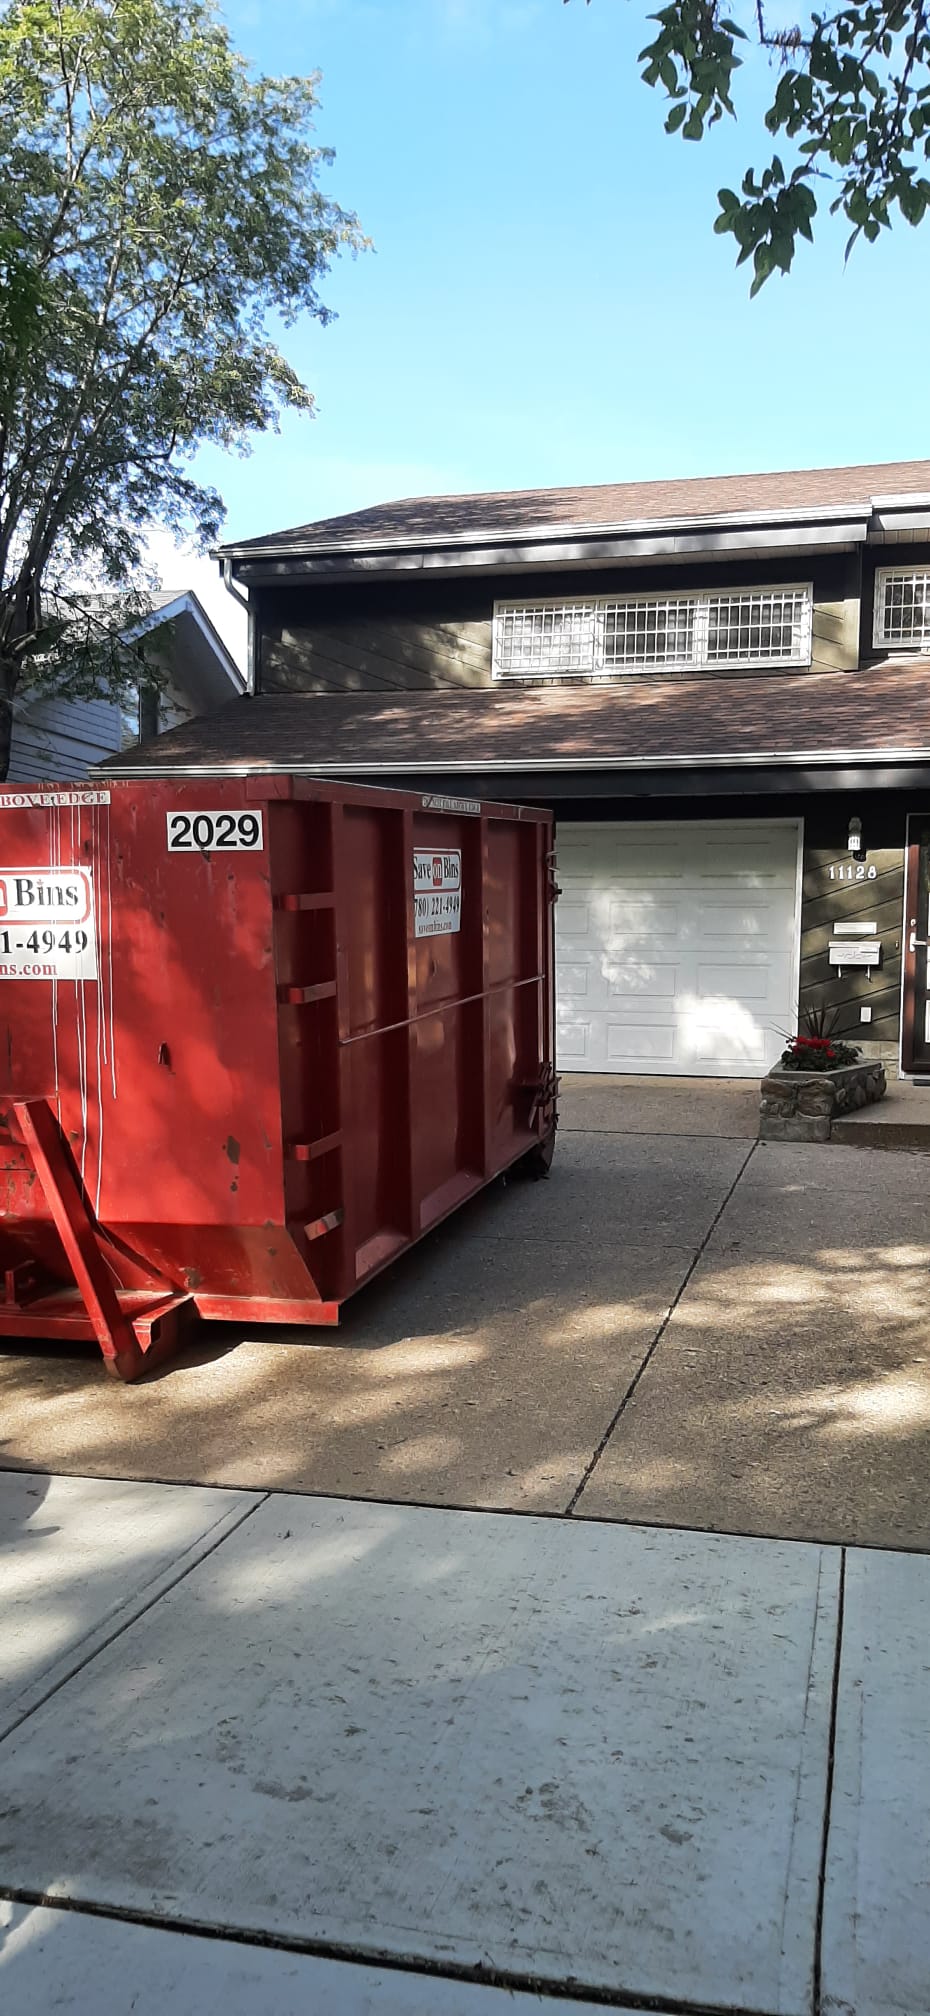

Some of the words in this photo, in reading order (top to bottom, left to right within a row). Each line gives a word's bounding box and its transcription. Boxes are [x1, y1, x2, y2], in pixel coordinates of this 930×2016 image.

[56, 792, 107, 805] EDGE
[170, 814, 260, 848] 2029
[413, 856, 431, 880] Save
[443, 856, 459, 879] Bins
[829, 865, 877, 880] 11128
[13, 878, 79, 907] Bins
[431, 895, 460, 915] 221-4949
